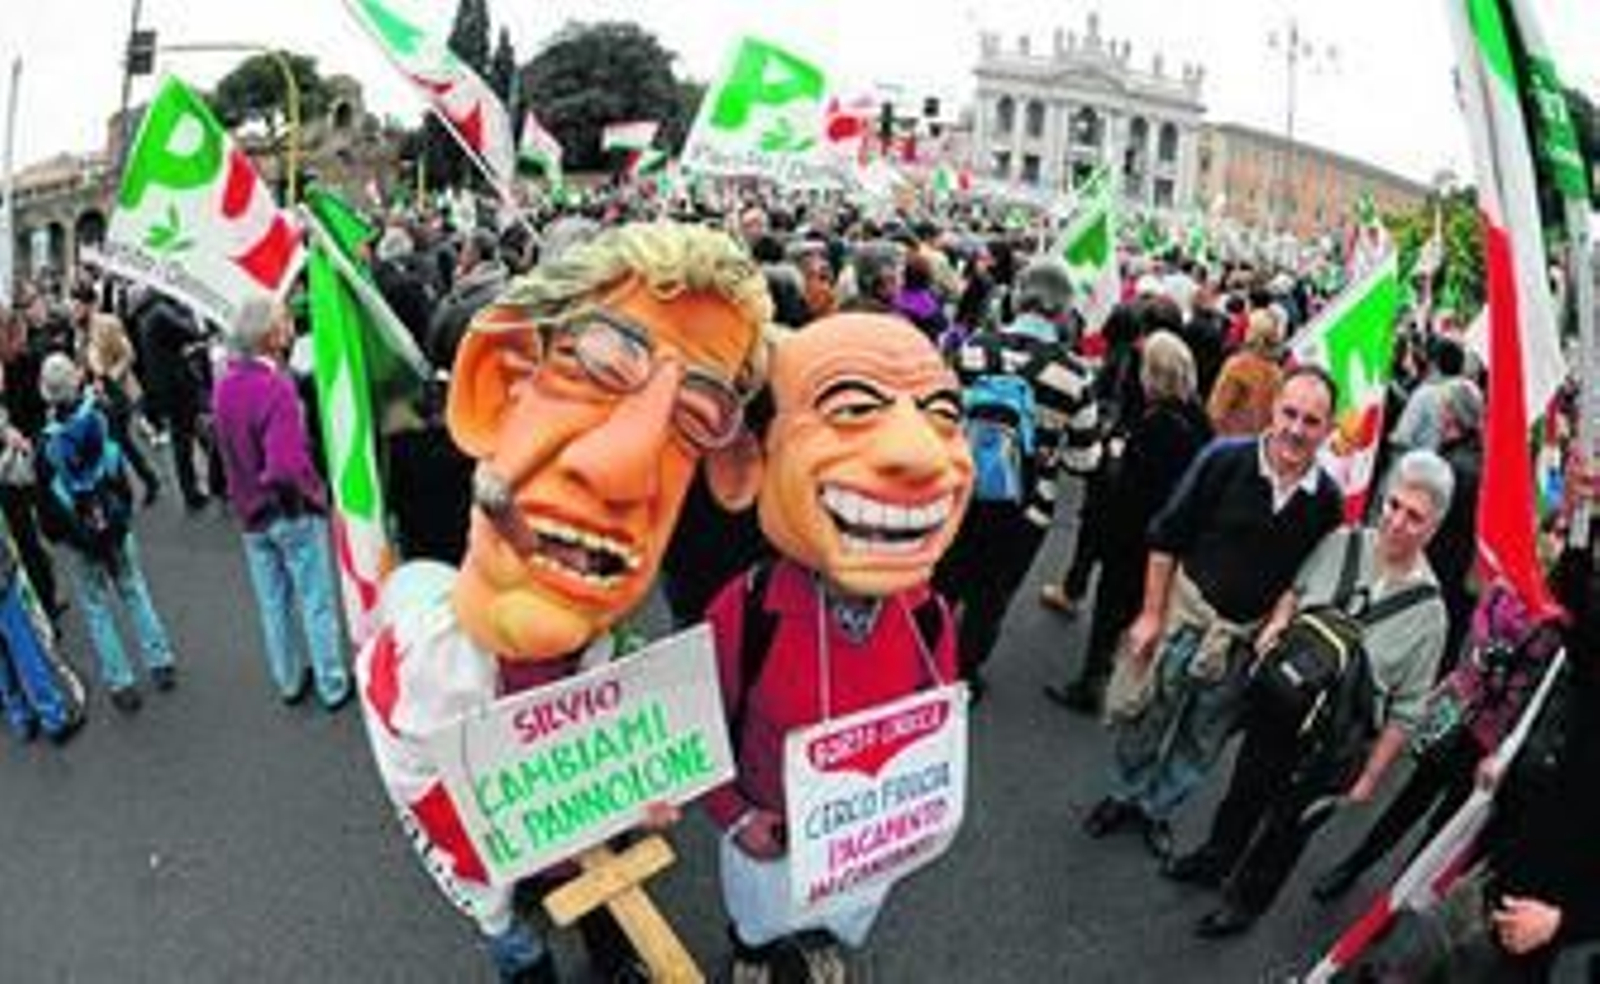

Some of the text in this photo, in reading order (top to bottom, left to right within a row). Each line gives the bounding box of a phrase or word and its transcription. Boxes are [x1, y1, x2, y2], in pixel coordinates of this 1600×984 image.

[513, 680, 621, 743] SILVIO
[475, 702, 669, 817] CAMBIAMI
[484, 828, 518, 864] IL
[523, 733, 713, 849] PANNOLONE
[805, 789, 878, 839] CERCO
